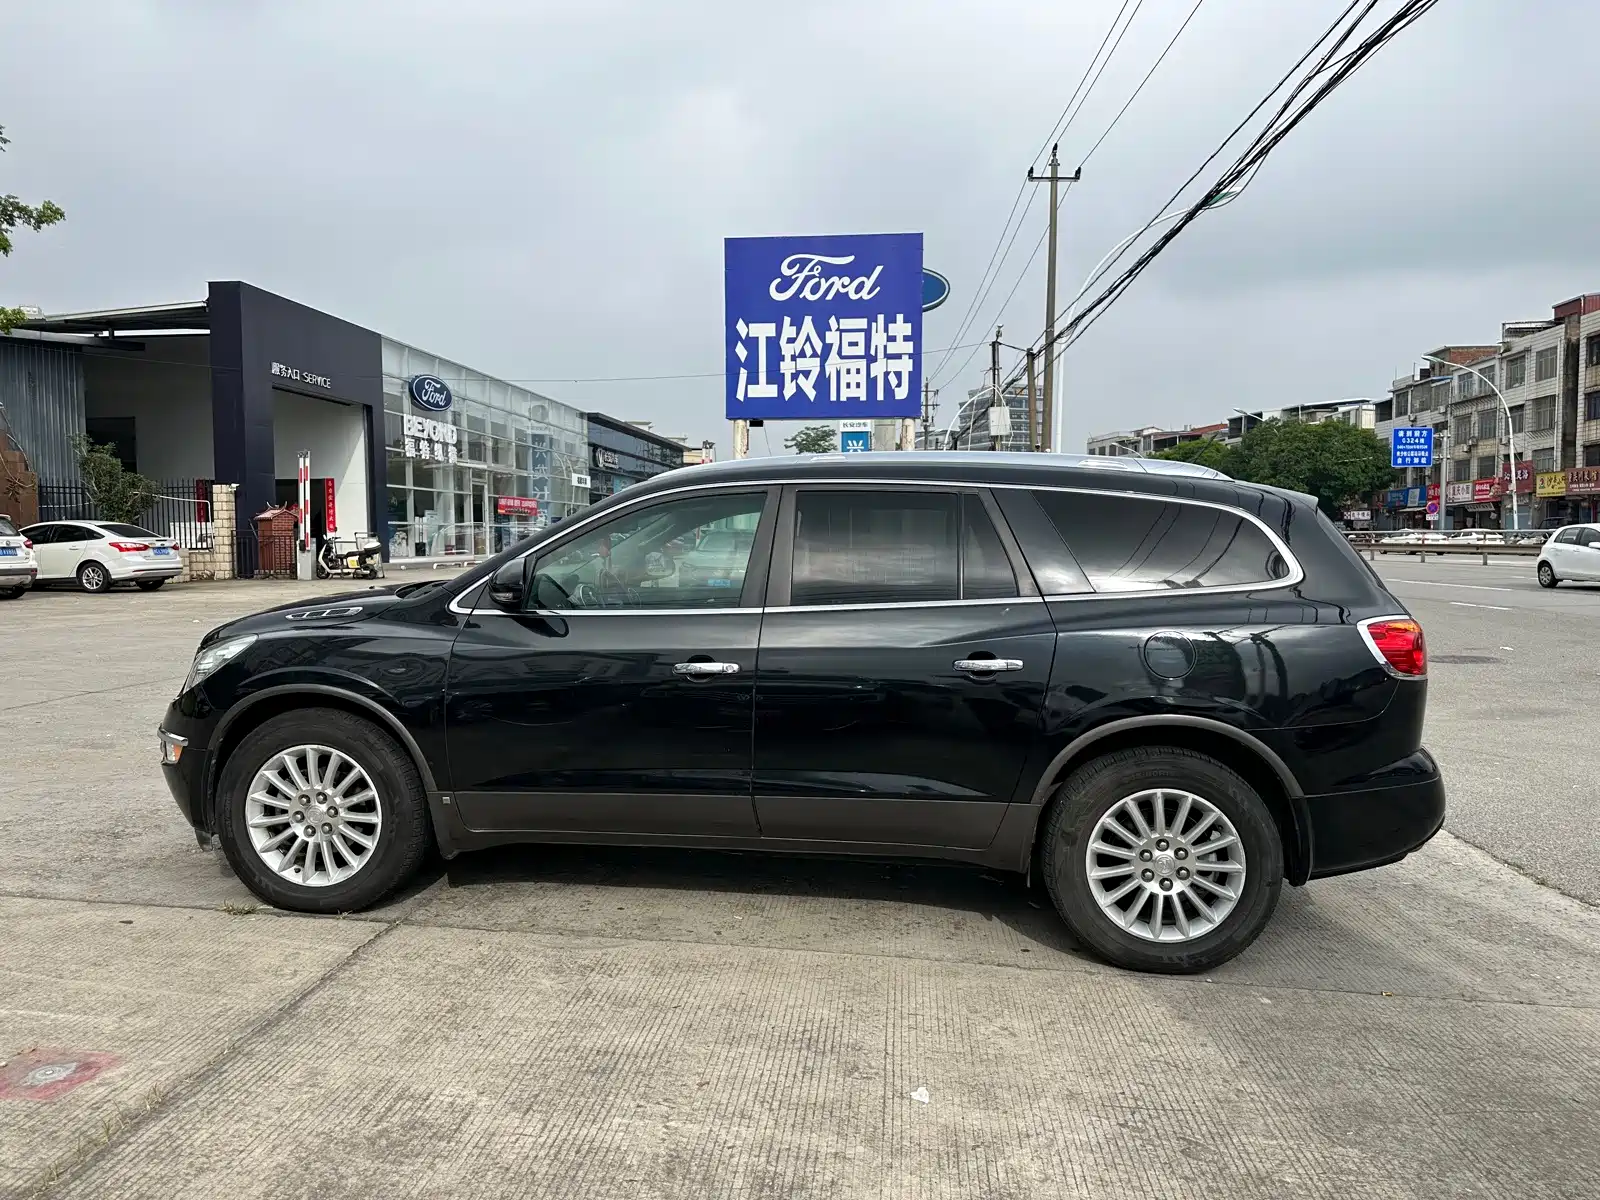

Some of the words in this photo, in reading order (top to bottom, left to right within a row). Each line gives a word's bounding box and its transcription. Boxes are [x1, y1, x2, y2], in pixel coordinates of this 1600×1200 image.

[769, 253, 884, 301] Ford
[735, 313, 914, 402] 江铃福特
[271, 362, 300, 380] 服务入口
[302, 372, 331, 389] SERVICE
[421, 379, 447, 406] Ford
[403, 413, 458, 445] BEYOND
